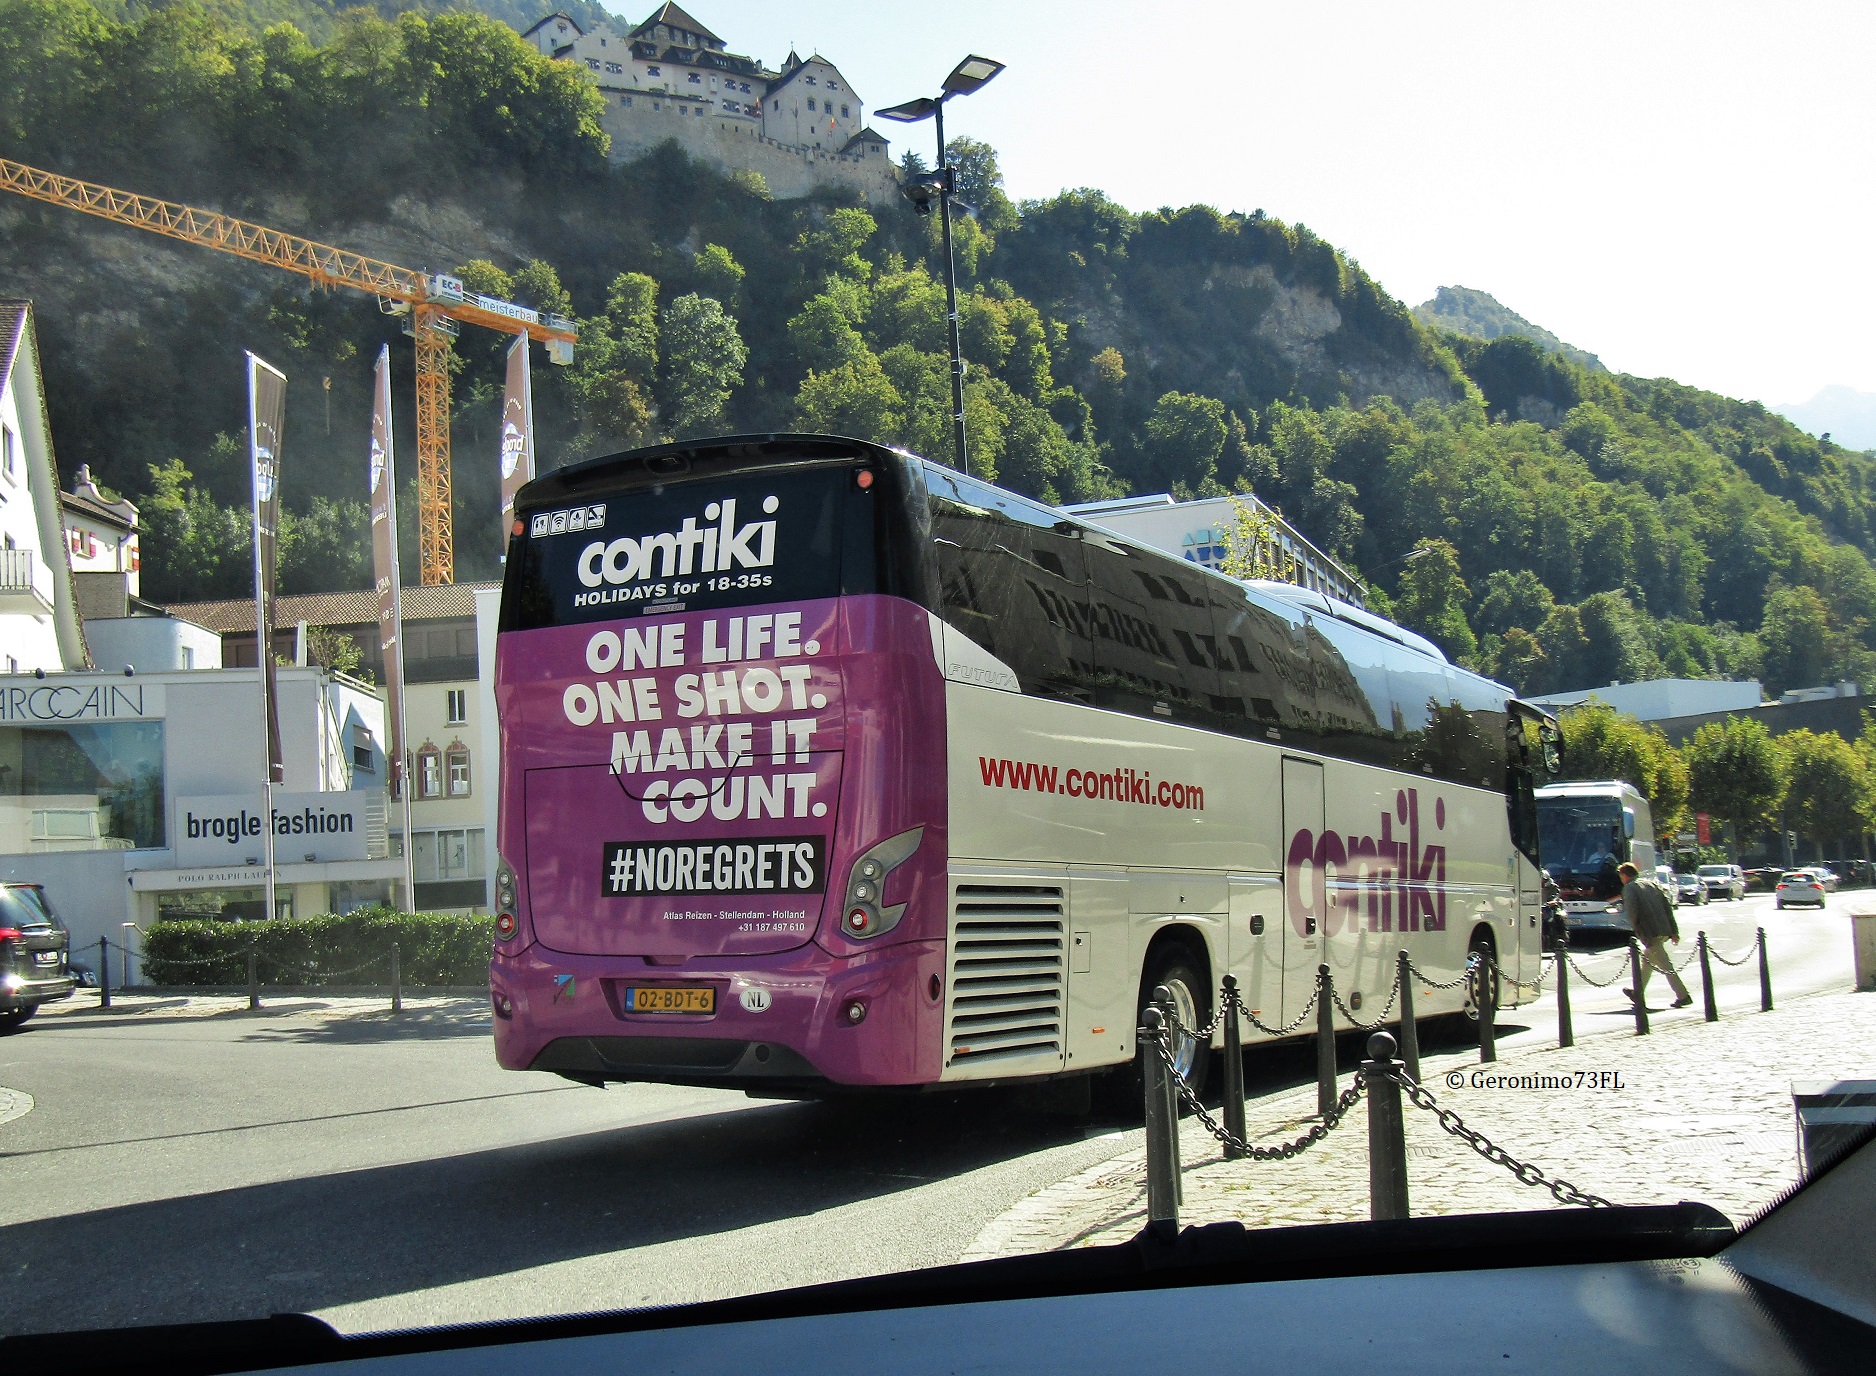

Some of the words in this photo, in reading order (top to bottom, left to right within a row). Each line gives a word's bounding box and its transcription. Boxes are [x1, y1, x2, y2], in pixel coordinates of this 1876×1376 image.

[480, 300, 538, 324] meisterbau
[577, 495, 779, 588] contiki
[574, 583, 667, 607] HOLIDAYS
[673, 581, 700, 596] for
[707, 574, 773, 591] 18-35s
[585, 622, 687, 674] ONE
[702, 611, 821, 663] LIFE.
[562, 677, 662, 727] ONE
[674, 664, 827, 719] SHOT.
[608, 722, 753, 776] MAKE
[771, 718, 817, 766] IT
[641, 772, 828, 824] COUNT.
[979, 756, 1204, 811] www.contiki.com
[187, 809, 261, 844] brogle
[271, 806, 353, 836] fashion
[178, 873, 205, 883] POLO
[208, 872, 240, 881] RALPH
[609, 842, 815, 892] #NOREGRETS
[1287, 787, 1446, 939] contiki
[663, 911, 683, 920] Atlas
[685, 911, 712, 920] Reizen
[719, 910, 765, 920] Stellendam
[772, 910, 805, 919] Holland
[738, 923, 753, 931] +31
[756, 923, 770, 931] 187
[773, 923, 788, 931] 497
[790, 922, 805, 931] 610
[639, 991, 709, 1008] 02-BDT-6
[747, 991, 765, 1008] NL
